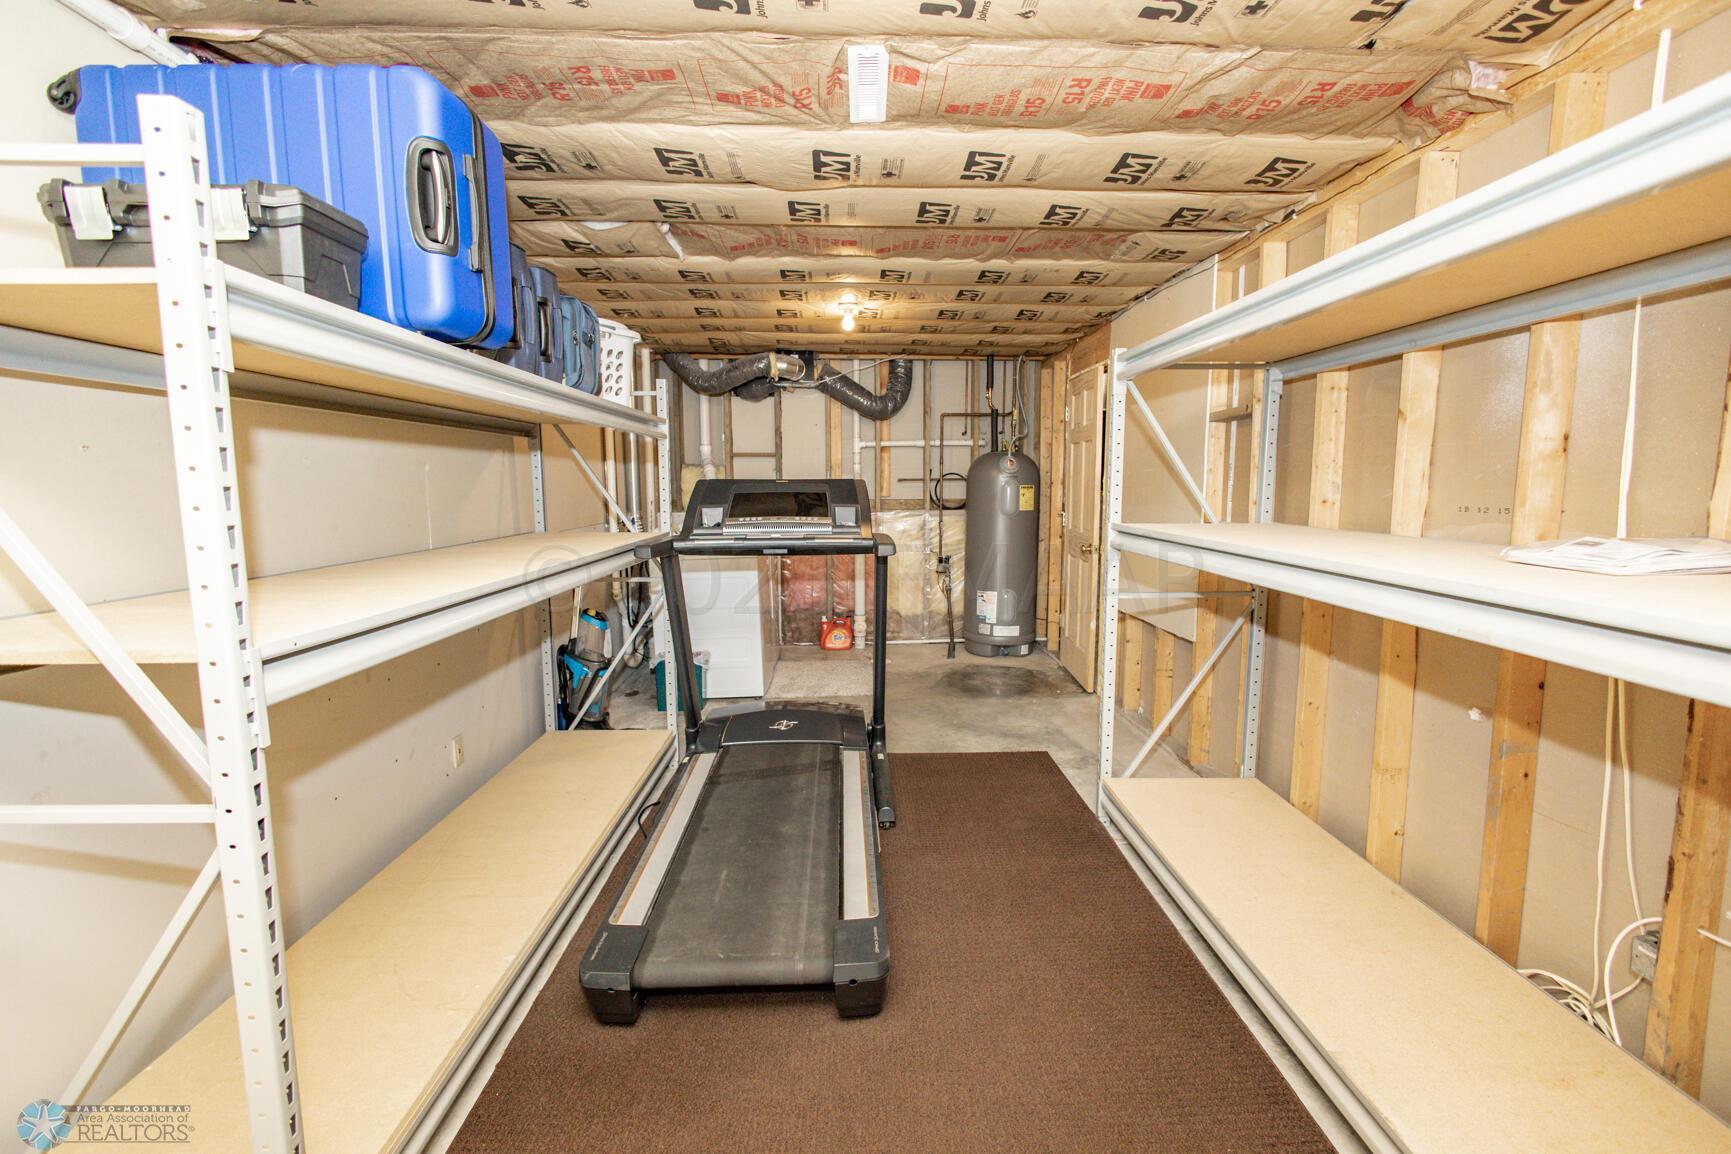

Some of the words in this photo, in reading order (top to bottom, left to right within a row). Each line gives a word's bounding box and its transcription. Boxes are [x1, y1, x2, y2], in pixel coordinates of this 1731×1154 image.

[568, 65, 601, 87] R15
[791, 87, 814, 110] R15
[1062, 78, 1092, 104] R15
[1119, 80, 1144, 102] PINK
[1297, 82, 1337, 106] R15
[1019, 97, 1046, 117] R15
[654, 147, 704, 178] JM
[812, 149, 851, 181] JM
[960, 151, 1007, 182] JM
[1103, 152, 1159, 185] JM
[1243, 157, 1307, 188] JM
[653, 199, 697, 220] JM
[788, 201, 821, 223] JM
[915, 201, 952, 224] JM
[1038, 204, 1082, 226] JM
